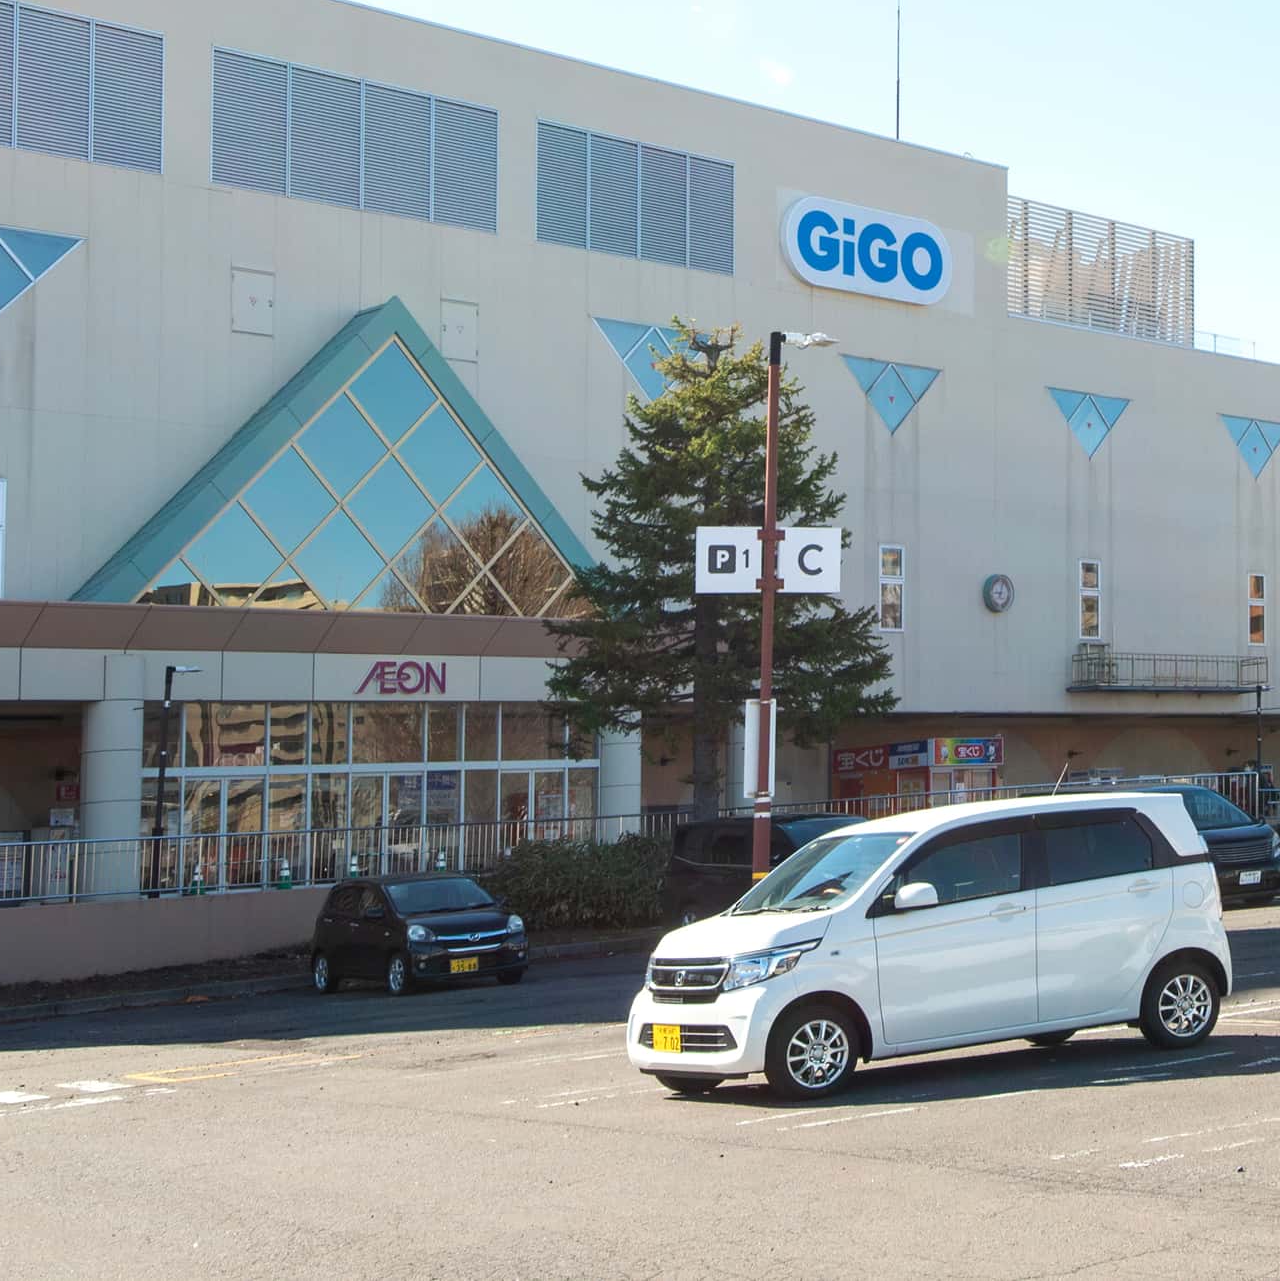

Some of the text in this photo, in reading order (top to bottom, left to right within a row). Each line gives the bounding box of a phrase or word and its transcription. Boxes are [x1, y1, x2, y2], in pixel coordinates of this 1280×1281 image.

[797, 209, 943, 291] GiGO
[742, 549, 750, 568] 1
[798, 543, 823, 576] C
